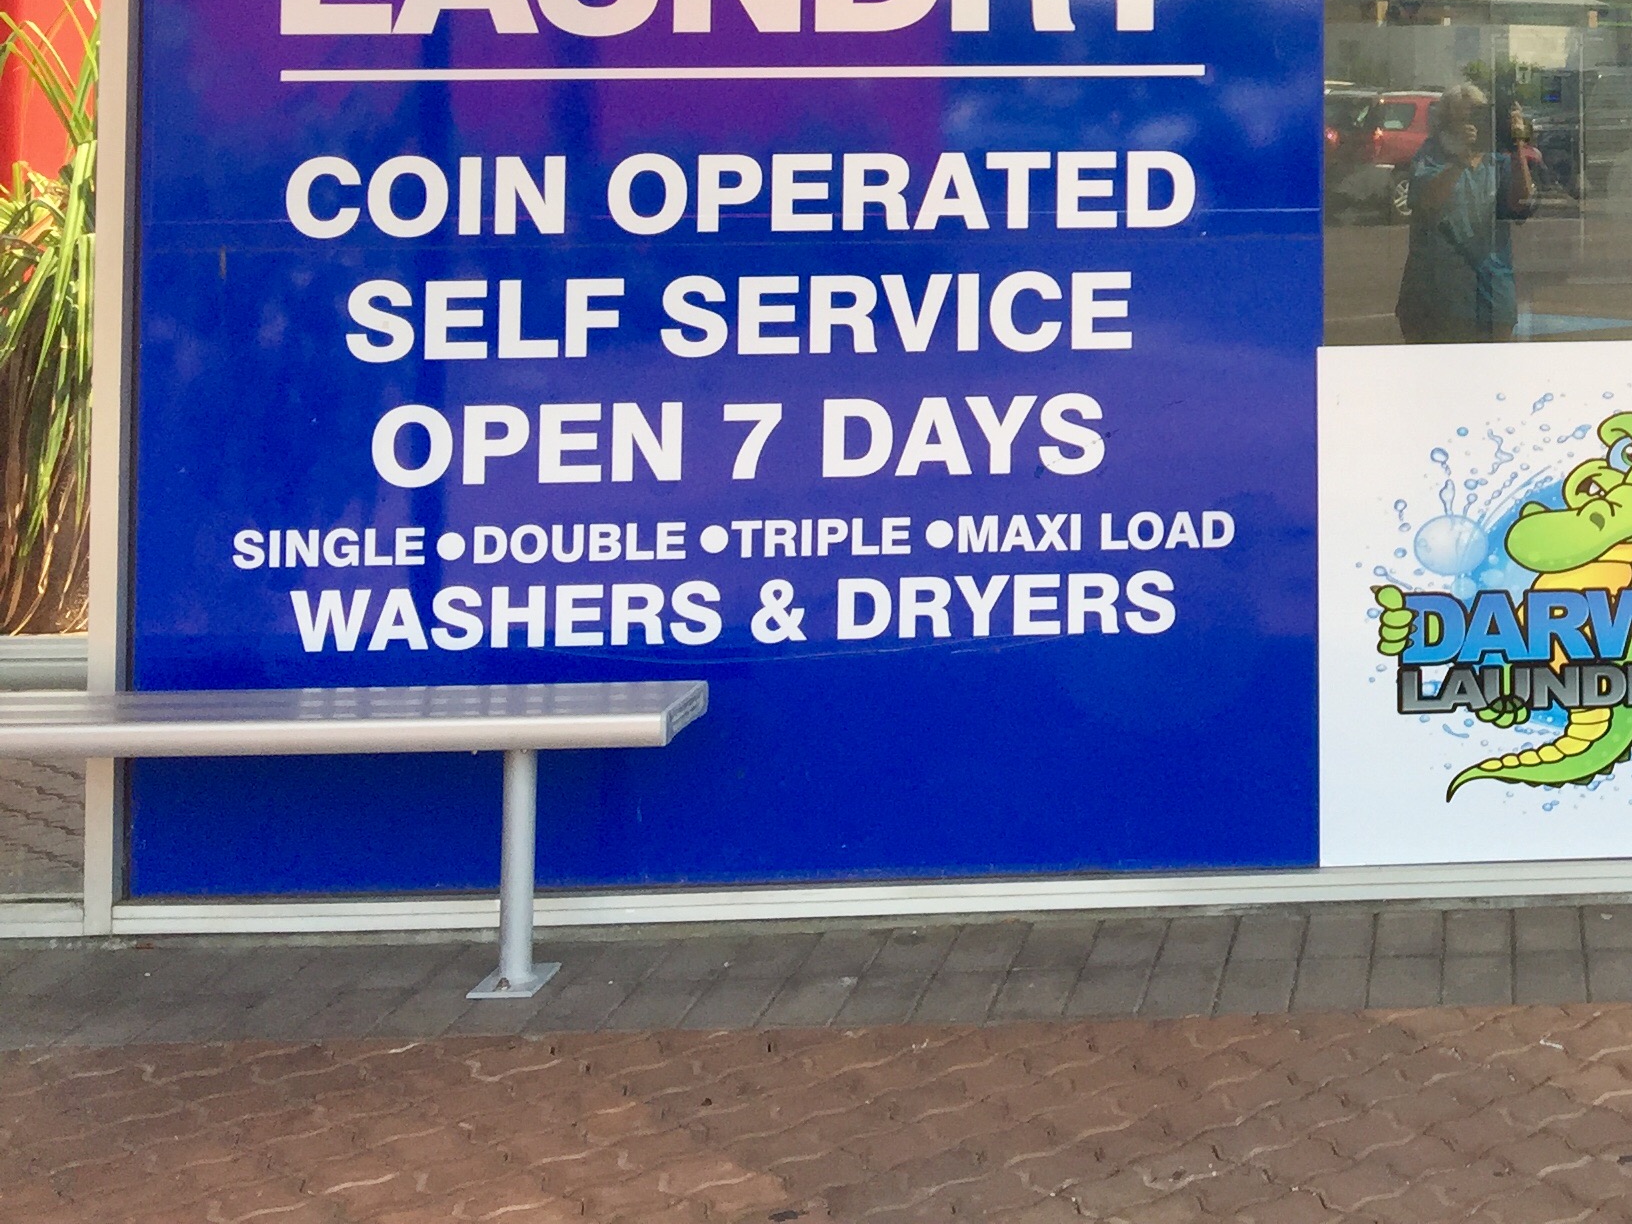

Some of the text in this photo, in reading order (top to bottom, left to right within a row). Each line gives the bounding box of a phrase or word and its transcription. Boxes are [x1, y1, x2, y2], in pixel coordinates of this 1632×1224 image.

[286, 151, 1195, 238] COIN OPERATED
[346, 271, 1132, 362] SELF SERVICE
[372, 393, 1105, 487] OPEN 7 DAYS
[233, 511, 1234, 569] SINGLE DOUBLE TRIPLE MAXI LOAD
[290, 571, 1175, 652] WASHERS & DRYERS
